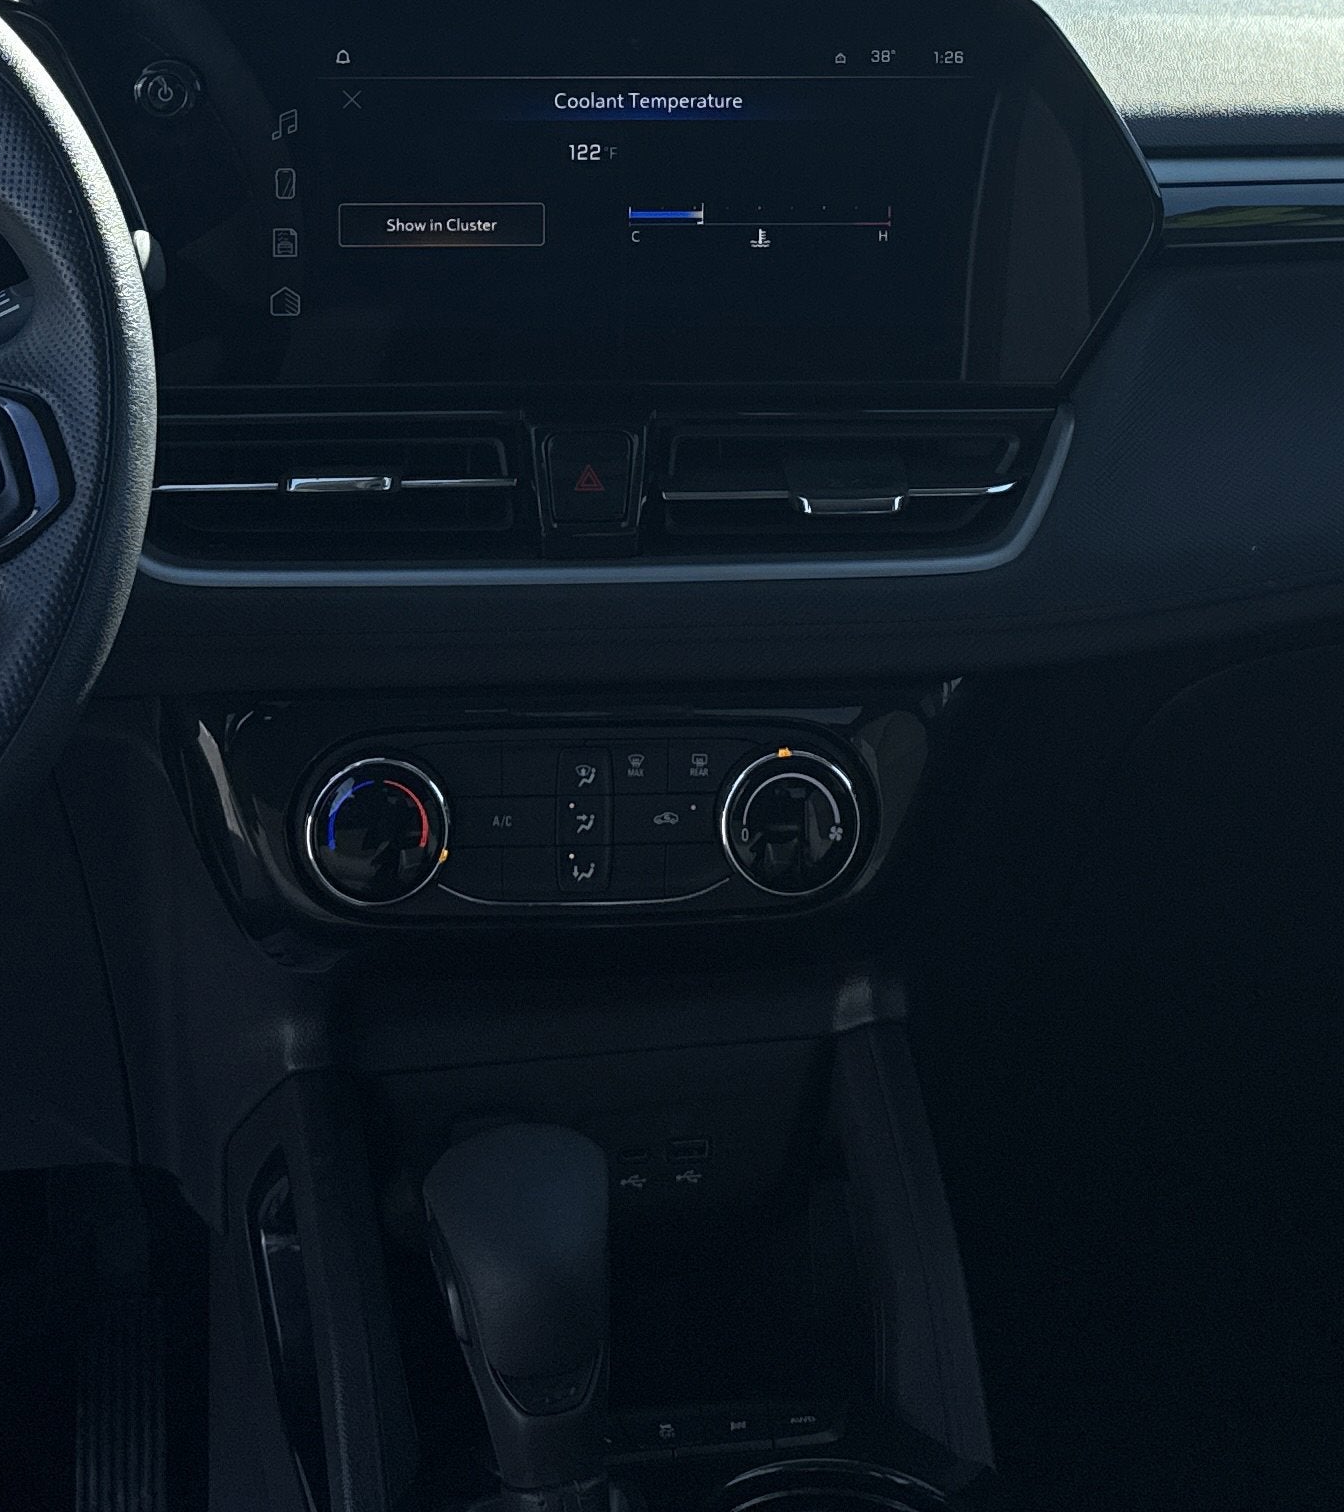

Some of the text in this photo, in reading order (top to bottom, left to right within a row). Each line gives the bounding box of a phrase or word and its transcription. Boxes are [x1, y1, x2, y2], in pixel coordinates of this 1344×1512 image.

[933, 50, 964, 65] 1:26
[554, 92, 744, 114] Coolant Temperature
[569, 144, 601, 162] 122
[387, 218, 498, 233] Show in Cluster
[630, 231, 641, 243] C
[878, 231, 888, 242] H
[628, 769, 644, 778] MAX
[689, 768, 709, 778] REAR
[492, 814, 512, 829] A/C
